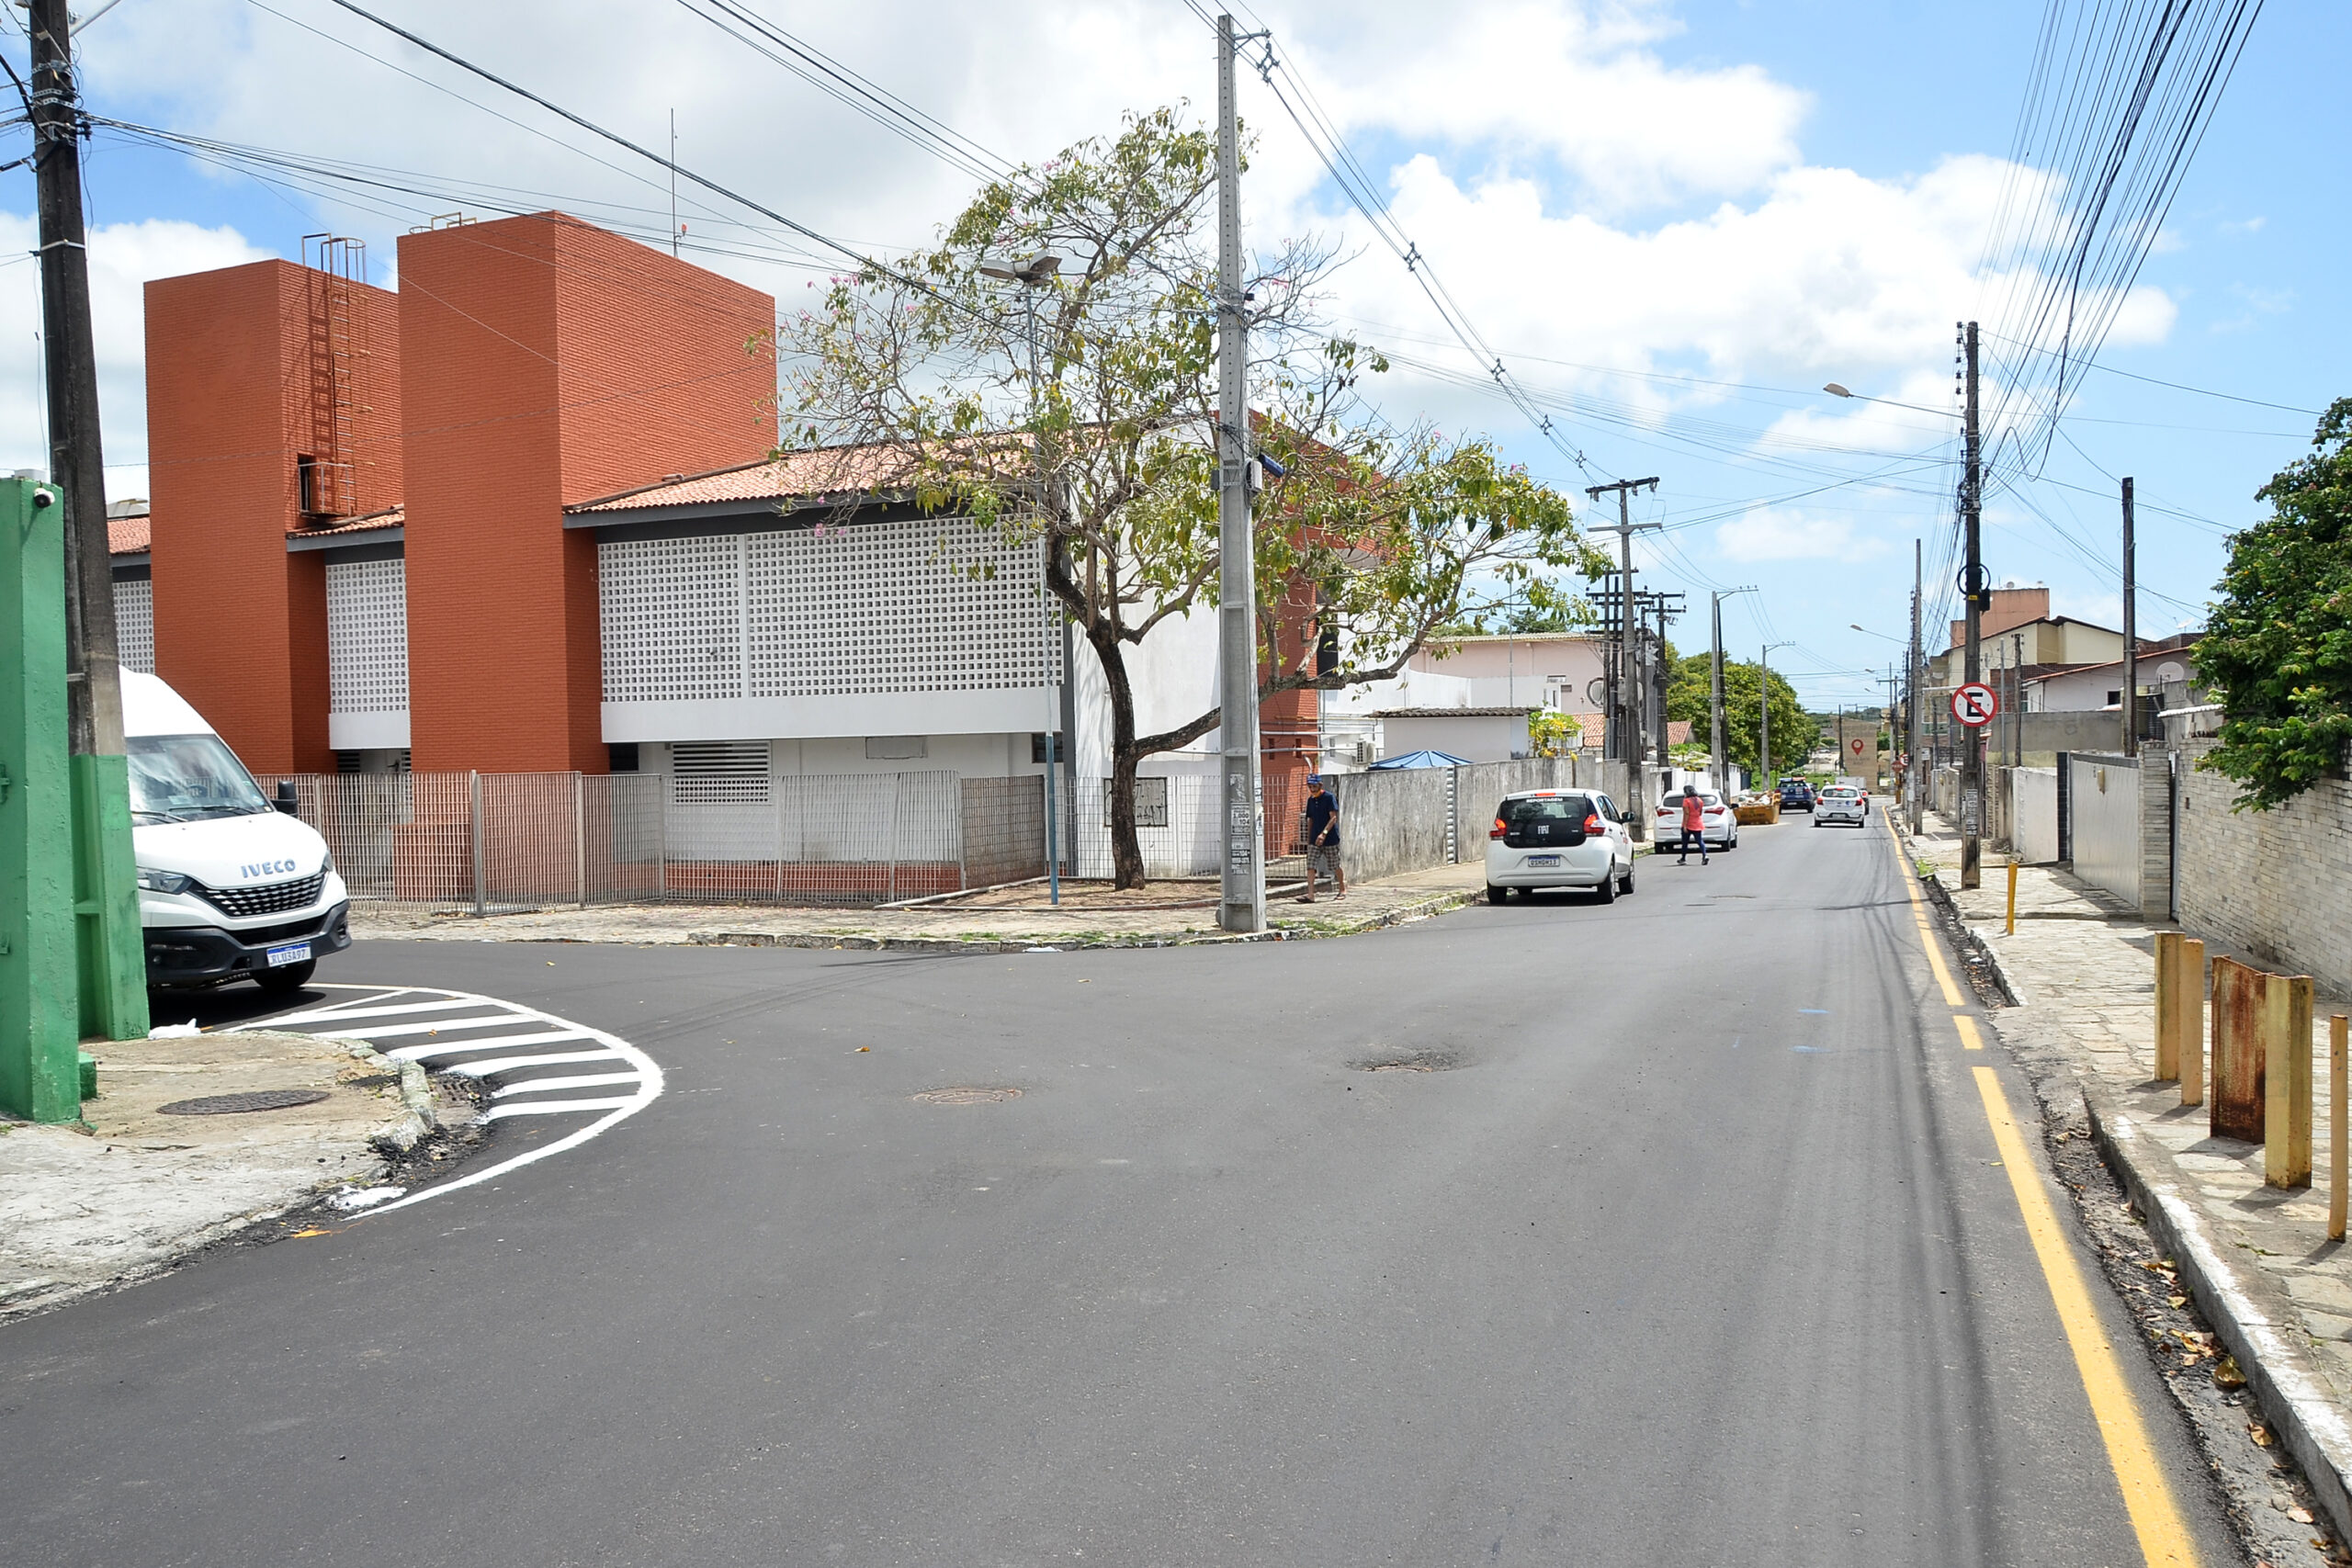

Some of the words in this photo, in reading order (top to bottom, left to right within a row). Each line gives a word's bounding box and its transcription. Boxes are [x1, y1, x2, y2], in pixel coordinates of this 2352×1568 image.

[1966, 692, 1983, 716] E
[1537, 825, 1550, 835] FIAT
[241, 859, 296, 878] IVECO
